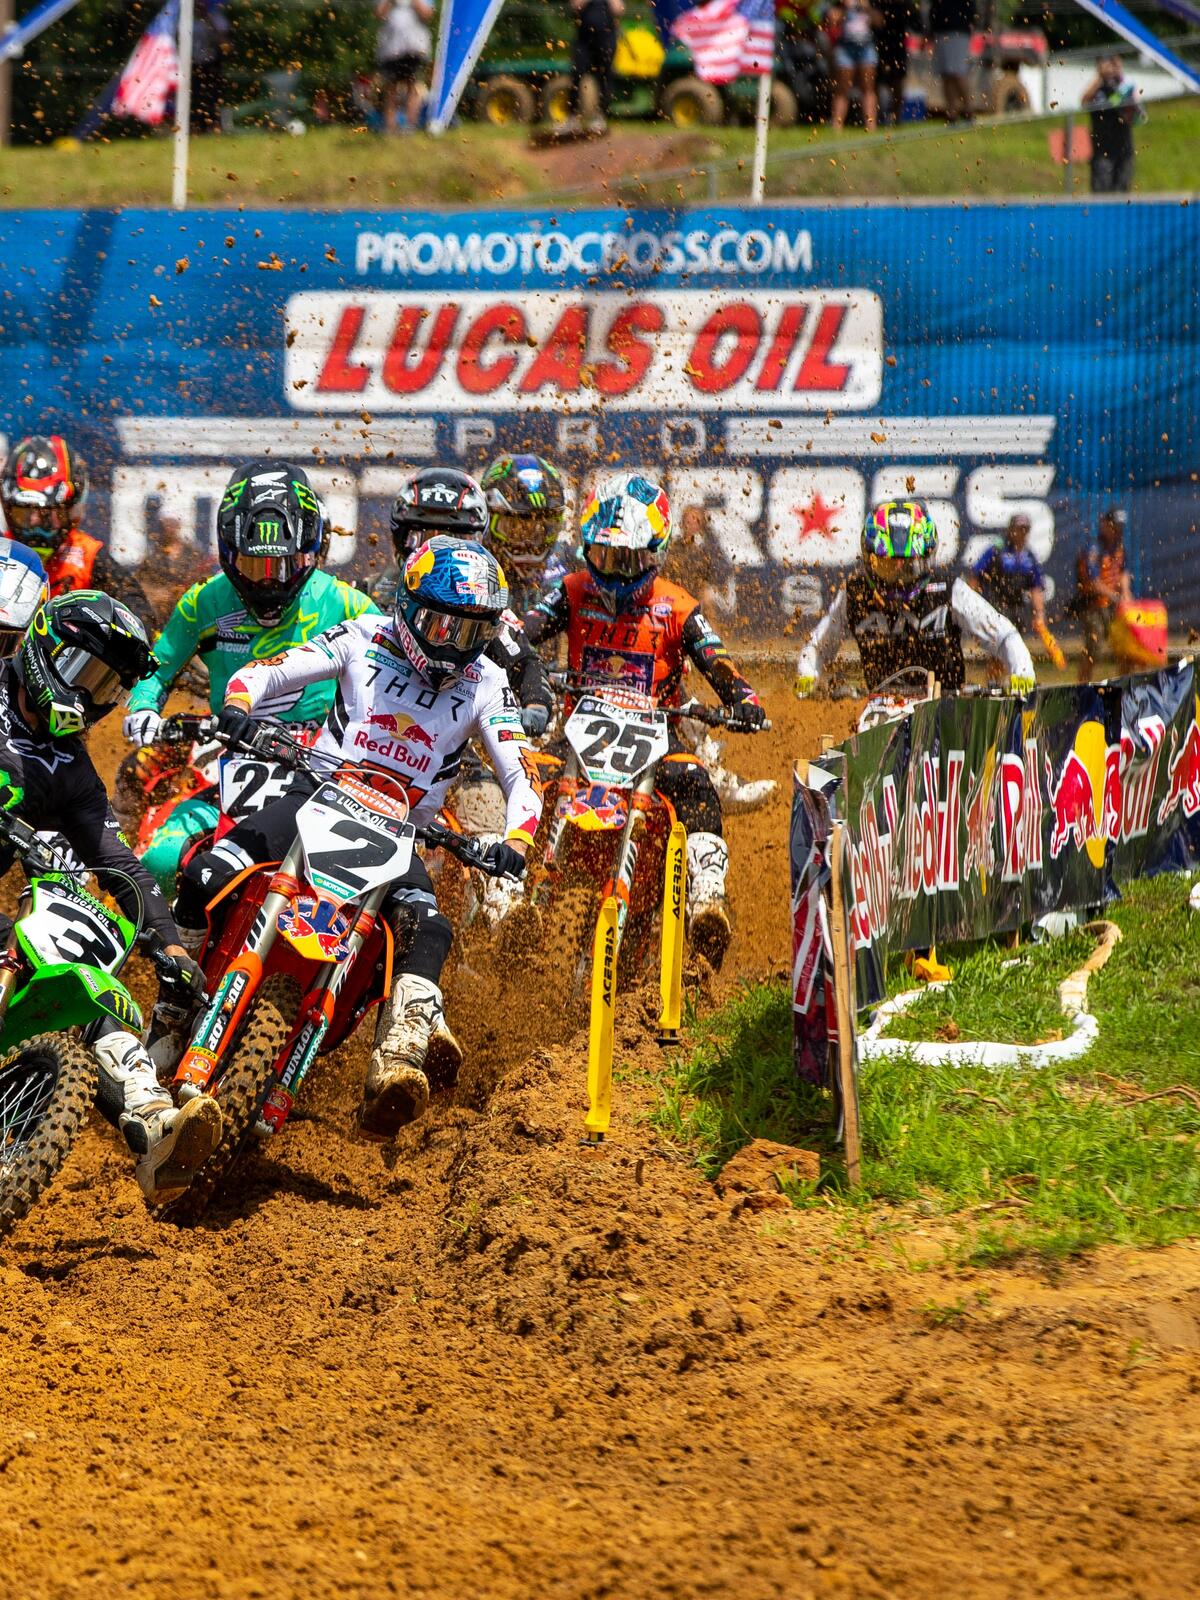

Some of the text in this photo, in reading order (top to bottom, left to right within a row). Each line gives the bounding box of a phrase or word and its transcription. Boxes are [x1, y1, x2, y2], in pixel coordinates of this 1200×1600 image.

[314, 303, 854, 396] LUCAS OIL
[420, 488, 459, 504] FLY
[248, 545, 289, 553] MONSTER
[456, 552, 480, 561] BELL
[353, 730, 432, 773] Red Bull
[580, 719, 658, 774] 25
[370, 815, 388, 830] OIL
[308, 819, 399, 891] 2
[66, 893, 110, 928] LUCAS OIL
[322, 880, 351, 898] MOTOREX
[672, 848, 684, 920] ACERBIS
[46, 902, 117, 967] 3
[602, 926, 615, 1008] ACERBIS
[281, 1023, 315, 1088] DUNLOP
[300, 1026, 328, 1079] MOTOREX
